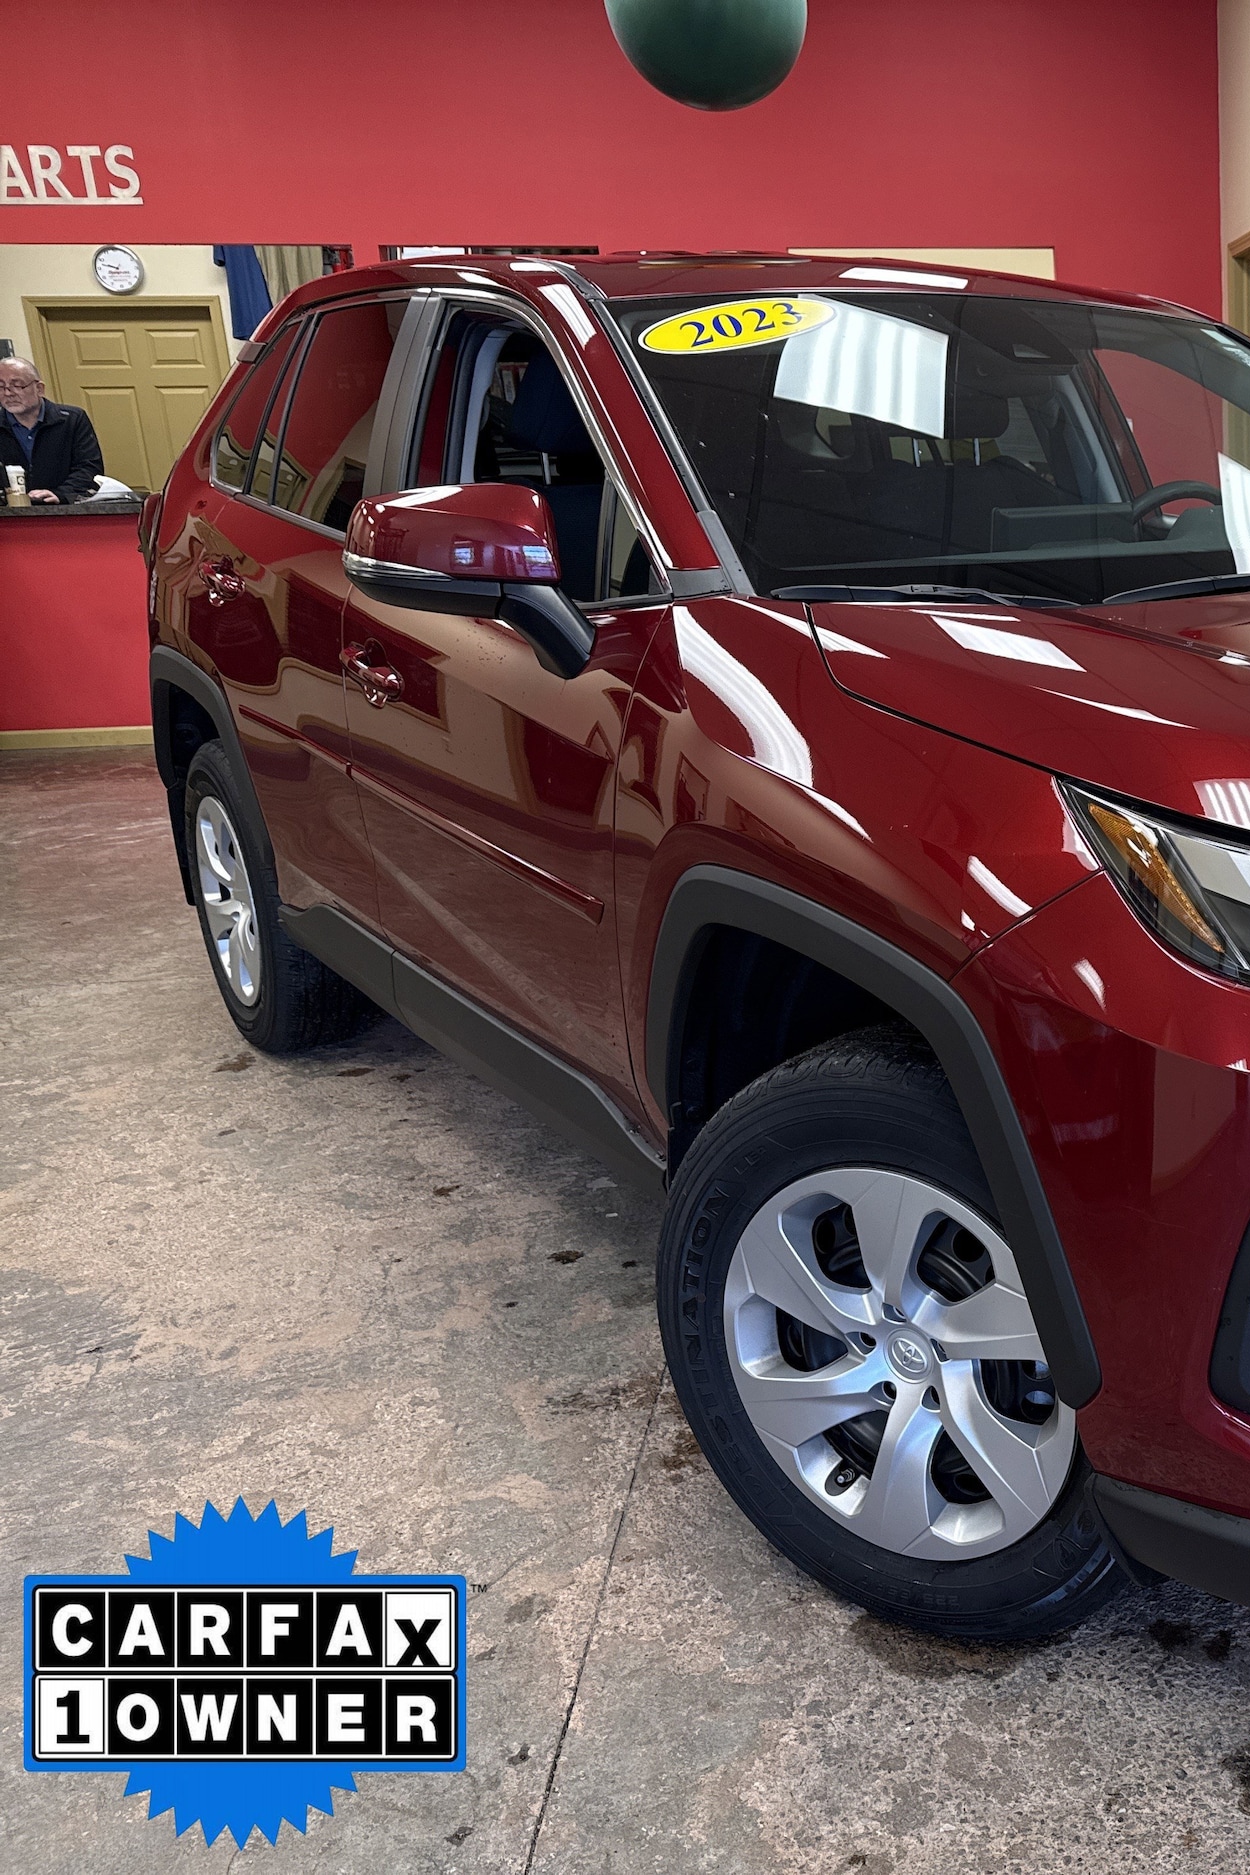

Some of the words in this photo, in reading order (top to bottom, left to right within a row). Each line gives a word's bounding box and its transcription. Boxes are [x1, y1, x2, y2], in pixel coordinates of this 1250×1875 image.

[0, 144, 141, 199] ARTS
[679, 302, 804, 347] 2023
[683, 1186, 778, 1507] DESTINATION
